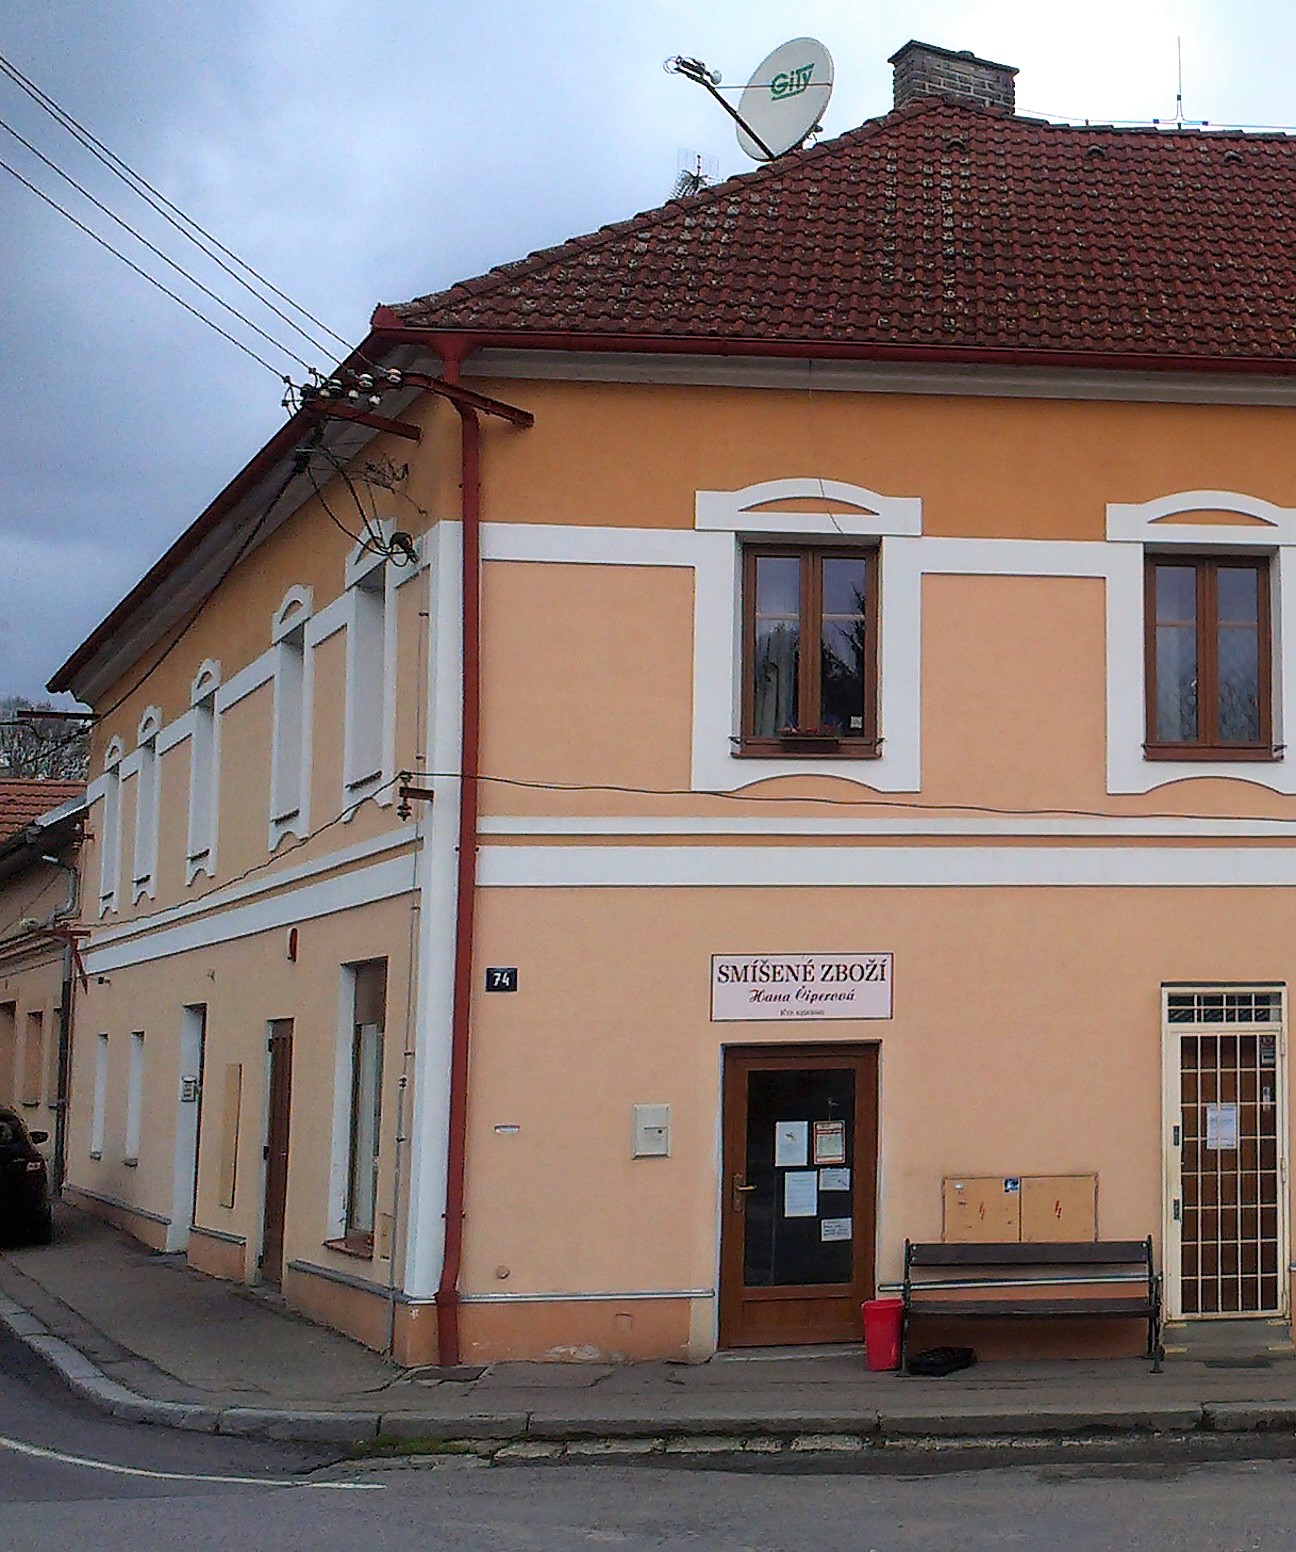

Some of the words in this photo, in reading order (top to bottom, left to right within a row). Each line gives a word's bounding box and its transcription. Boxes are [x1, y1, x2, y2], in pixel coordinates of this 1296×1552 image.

[717, 958, 815, 984] SMÍŠENÉ
[820, 957, 887, 983] ZBOŽÍ
[493, 972, 510, 987] 74
[749, 989, 791, 1003] Hana
